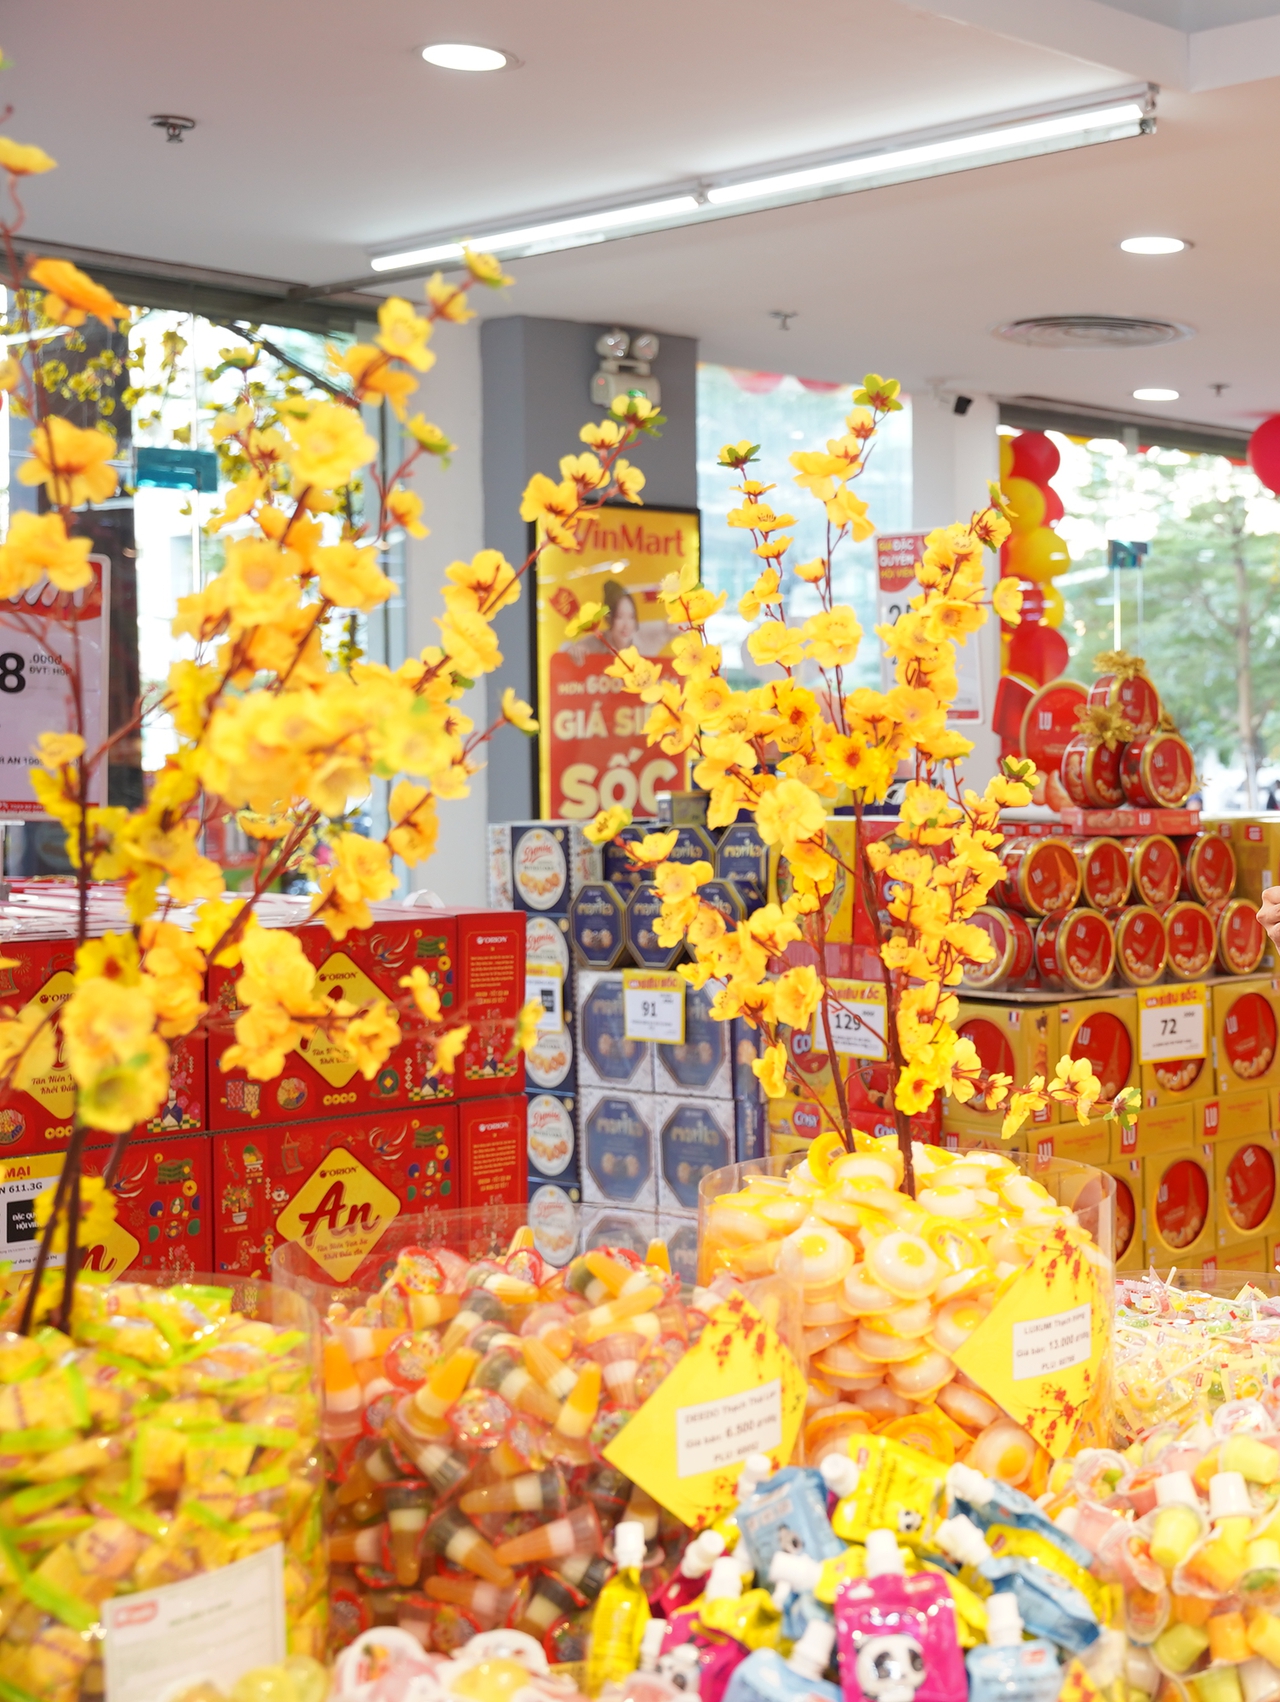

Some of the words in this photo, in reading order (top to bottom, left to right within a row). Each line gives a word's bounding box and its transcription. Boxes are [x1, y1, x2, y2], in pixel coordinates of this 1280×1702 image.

[553, 702, 608, 740] GIÁ
[642, 1001, 657, 1017] 91
[835, 1014, 862, 1031] 129
[1161, 1019, 1177, 1036] 72
[328, 1166, 357, 1177] ORION
[9, 1182, 42, 1194] 611.3G
[299, 1180, 380, 1249] An
